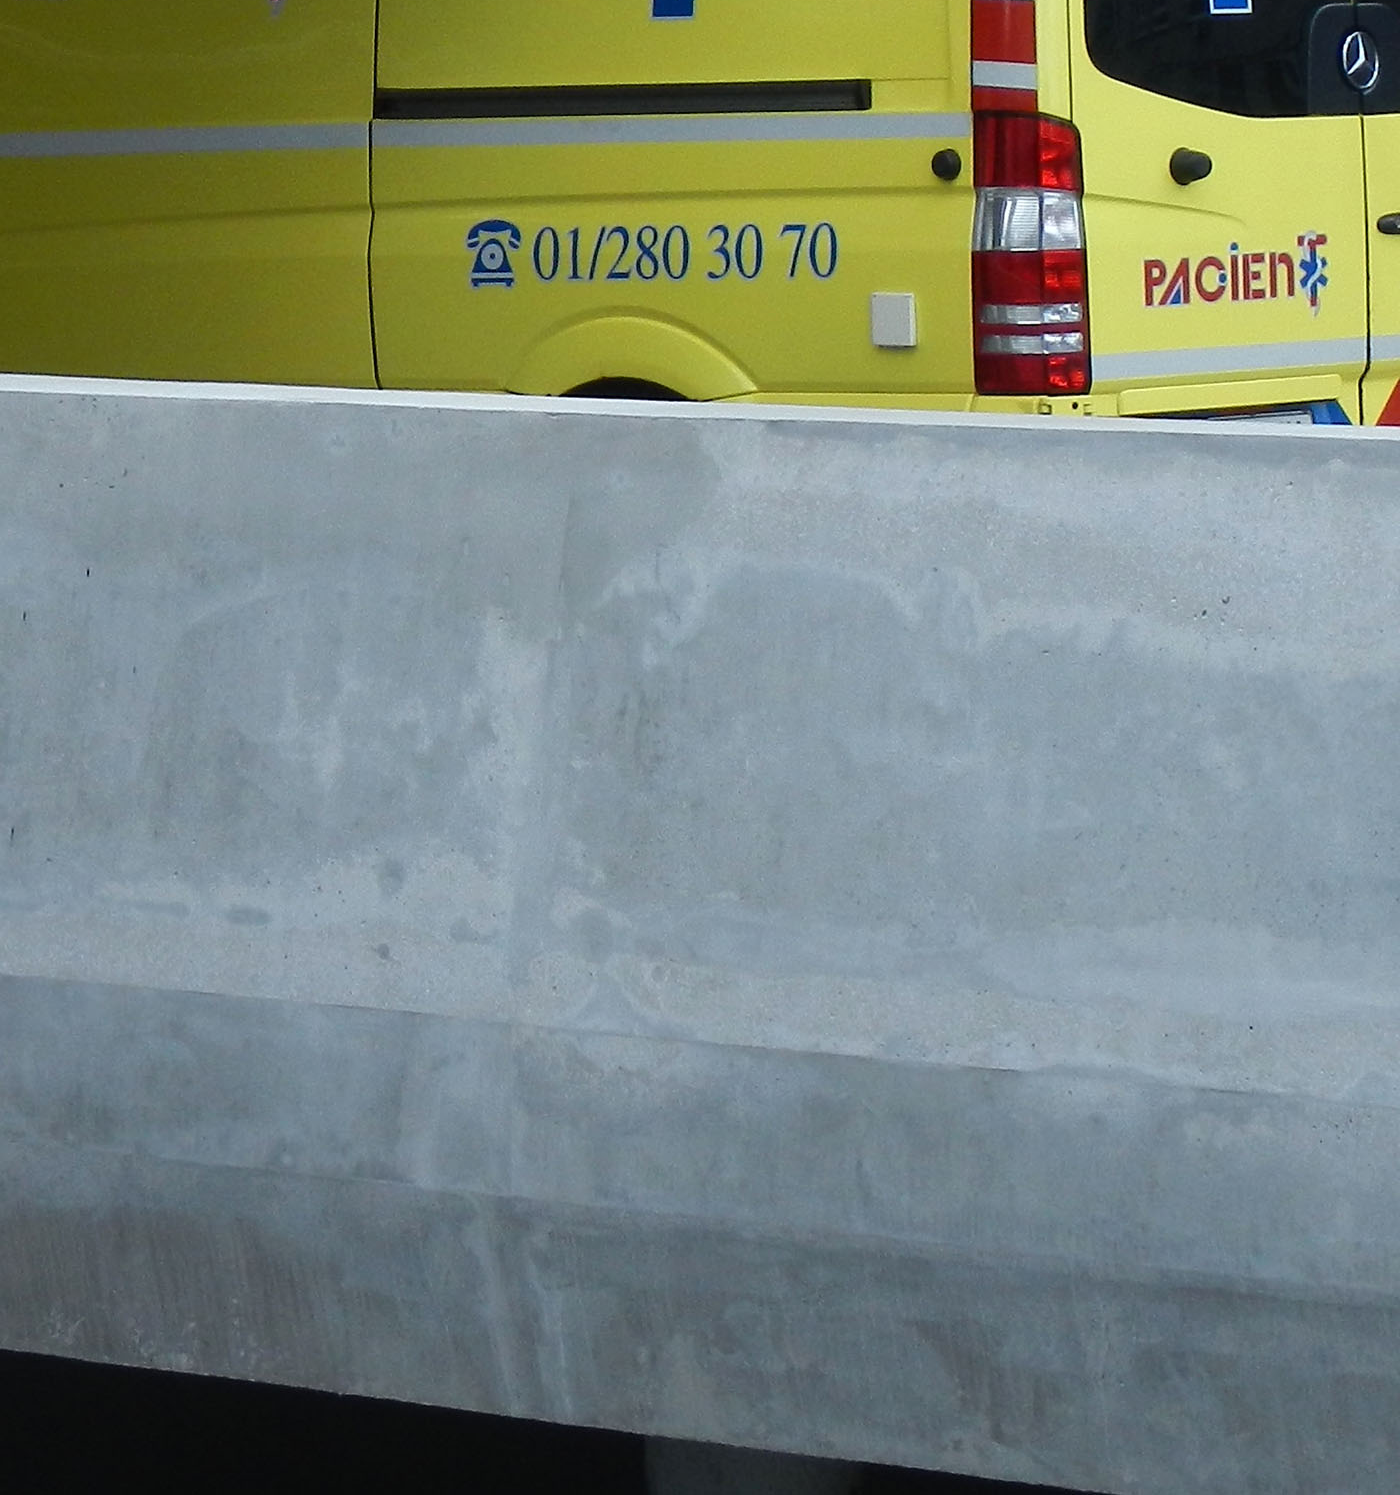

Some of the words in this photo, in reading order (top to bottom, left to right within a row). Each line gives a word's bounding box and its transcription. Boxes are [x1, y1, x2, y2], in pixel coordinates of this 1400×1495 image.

[532, 224, 690, 282] 01/280
[706, 223, 764, 280] 30
[778, 221, 839, 279] 70
